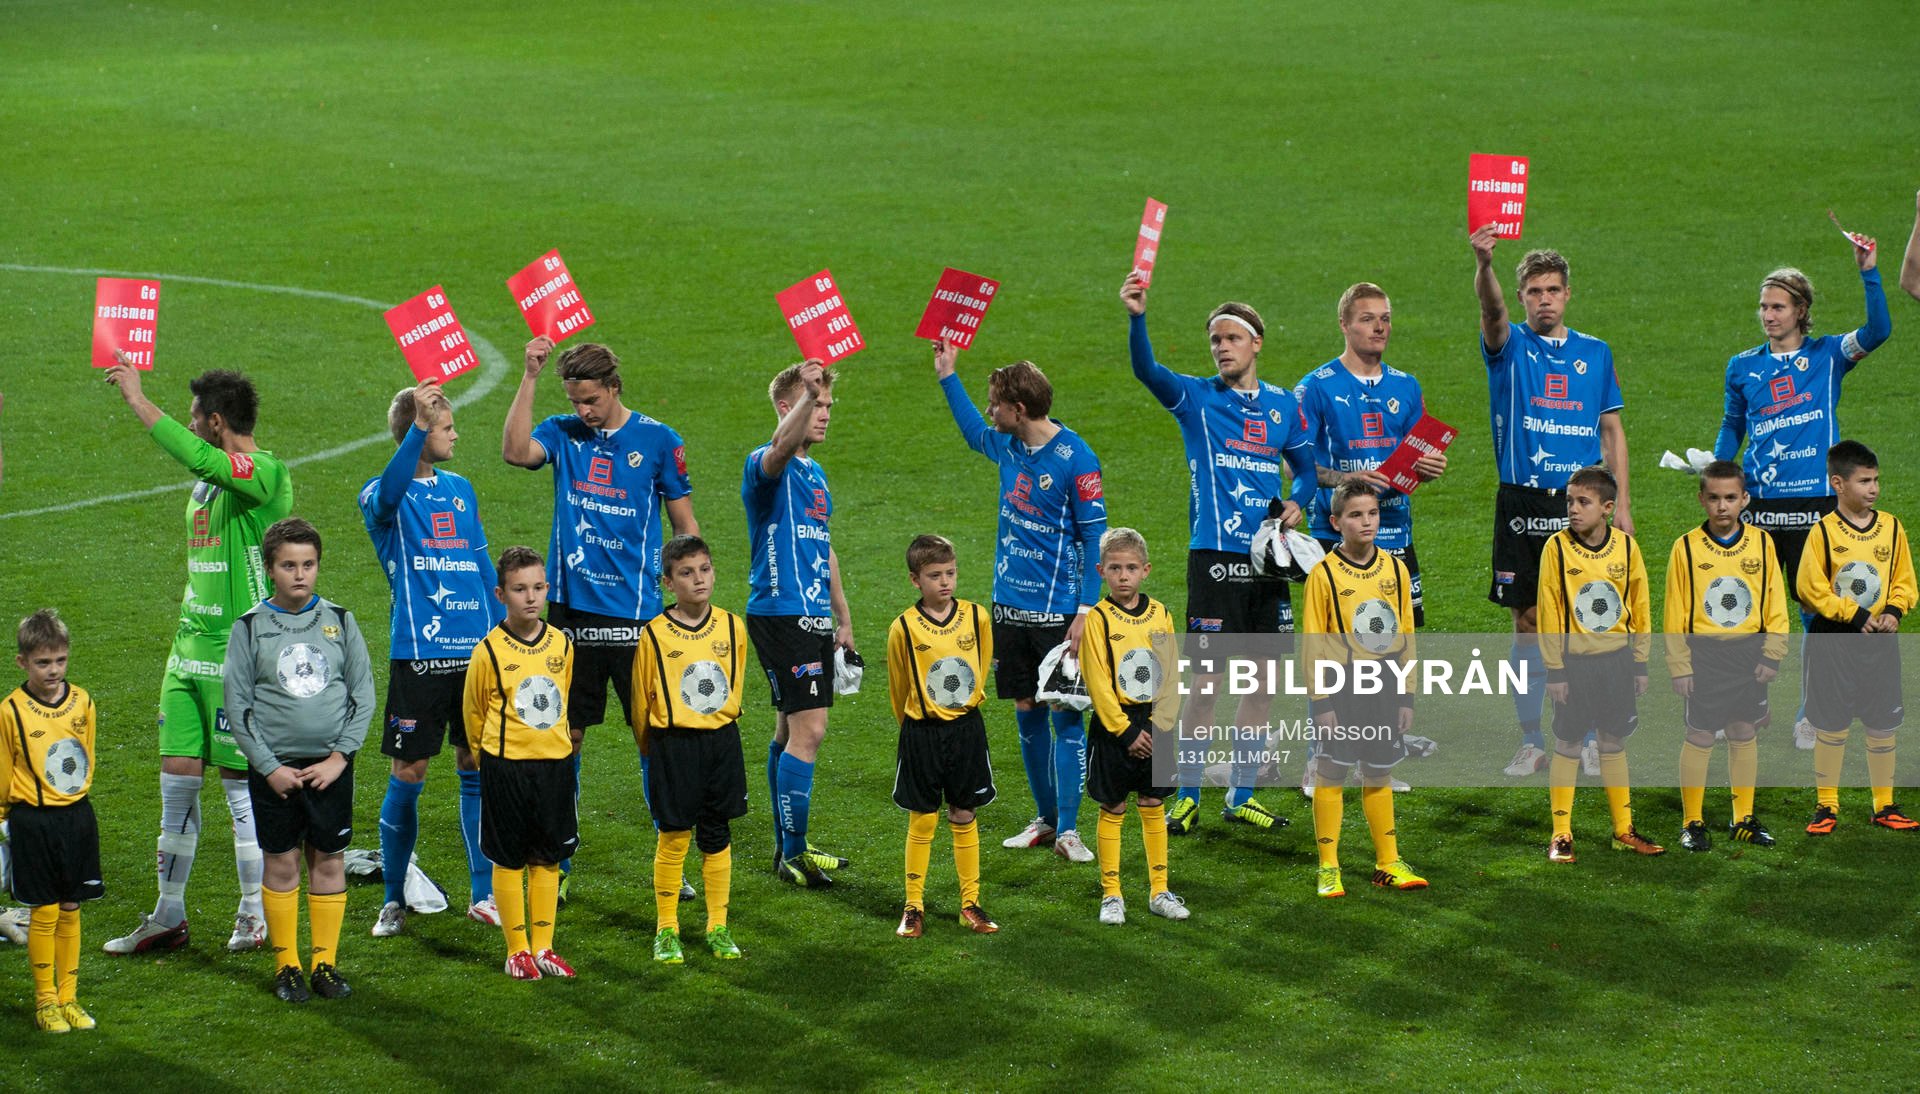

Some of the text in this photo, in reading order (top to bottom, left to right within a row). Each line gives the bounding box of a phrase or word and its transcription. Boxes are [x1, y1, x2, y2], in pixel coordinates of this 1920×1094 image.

[1511, 160, 1526, 175] Ge
[1471, 178, 1525, 195] rasismen
[1501, 200, 1523, 215] rött
[543, 256, 561, 272] Ge
[140, 285, 157, 301] Ge
[520, 272, 570, 312] rasismen
[815, 277, 832, 293] Ge
[979, 281, 995, 296] Ge
[426, 293, 445, 310] Ge
[555, 289, 580, 311] rött
[935, 289, 987, 311] rasismen
[98, 304, 155, 321] rasismen
[789, 295, 842, 329] rasismen
[955, 313, 980, 328] rött
[399, 311, 455, 348] rasismen
[556, 312, 584, 334] kort
[826, 313, 852, 335] rött
[129, 327, 153, 343] rött
[439, 331, 465, 352] rött
[827, 336, 854, 358] kort
[440, 354, 468, 376] kort
[1522, 415, 1594, 437] BilMånsson
[1754, 408, 1824, 437] BilMånsson
[1441, 431, 1454, 445] Ge
[1779, 445, 1818, 461] bravida
[1215, 453, 1281, 475] BilMånsson
[1340, 456, 1386, 472] BilMån
[1544, 460, 1584, 473] bravida
[1392, 472, 1413, 489] kort
[585, 531, 625, 551] bravida
[1010, 543, 1045, 561] bravida
[413, 555, 480, 573] BilMånsson
[445, 598, 480, 611] bravida
[1199, 634, 1209, 650] 8
[810, 680, 819, 696] 4
[395, 733, 403, 750] 2
